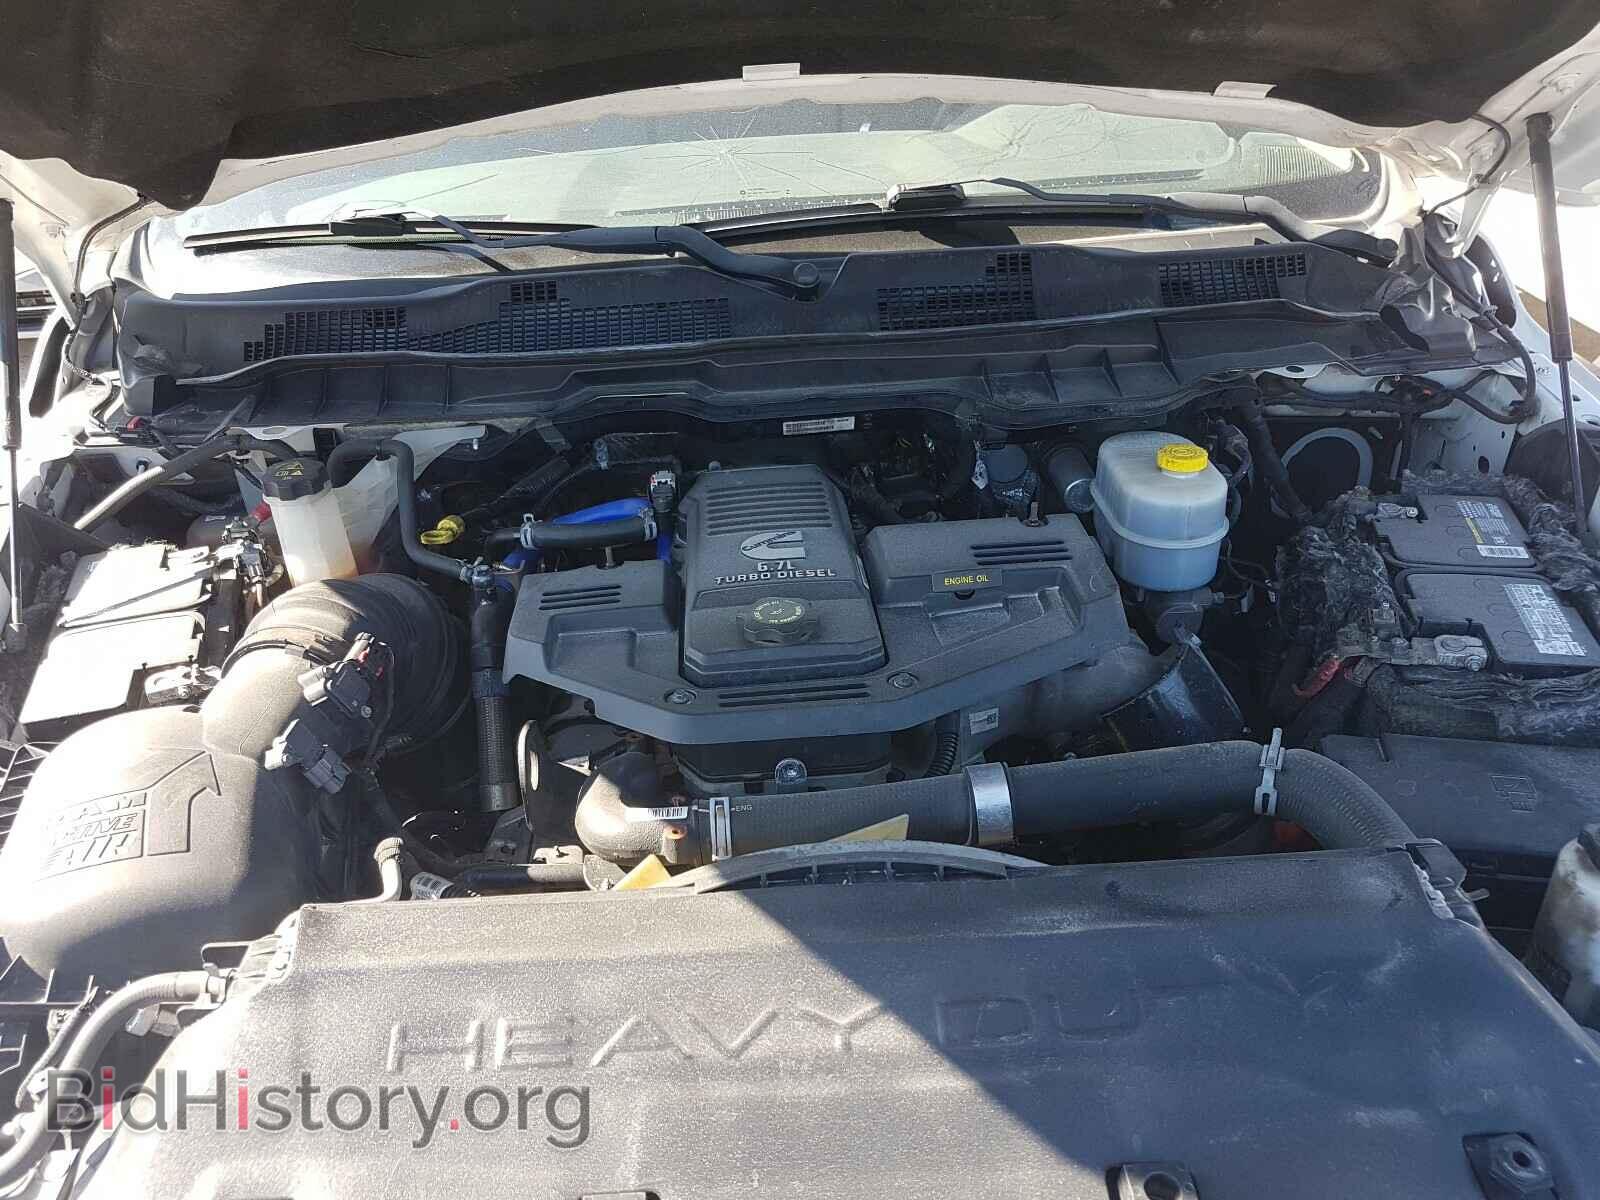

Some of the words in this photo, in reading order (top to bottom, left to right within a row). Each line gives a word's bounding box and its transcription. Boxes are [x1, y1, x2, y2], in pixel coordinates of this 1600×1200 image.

[757, 560, 796, 572] 6.7L
[714, 572, 771, 585] TURBO
[777, 568, 837, 579] DIESEL
[944, 575, 975, 586] ENGINE
[976, 574, 990, 582] OIL
[735, 804, 753, 812] ENG
[386, 1002, 882, 1073] HEAVY
